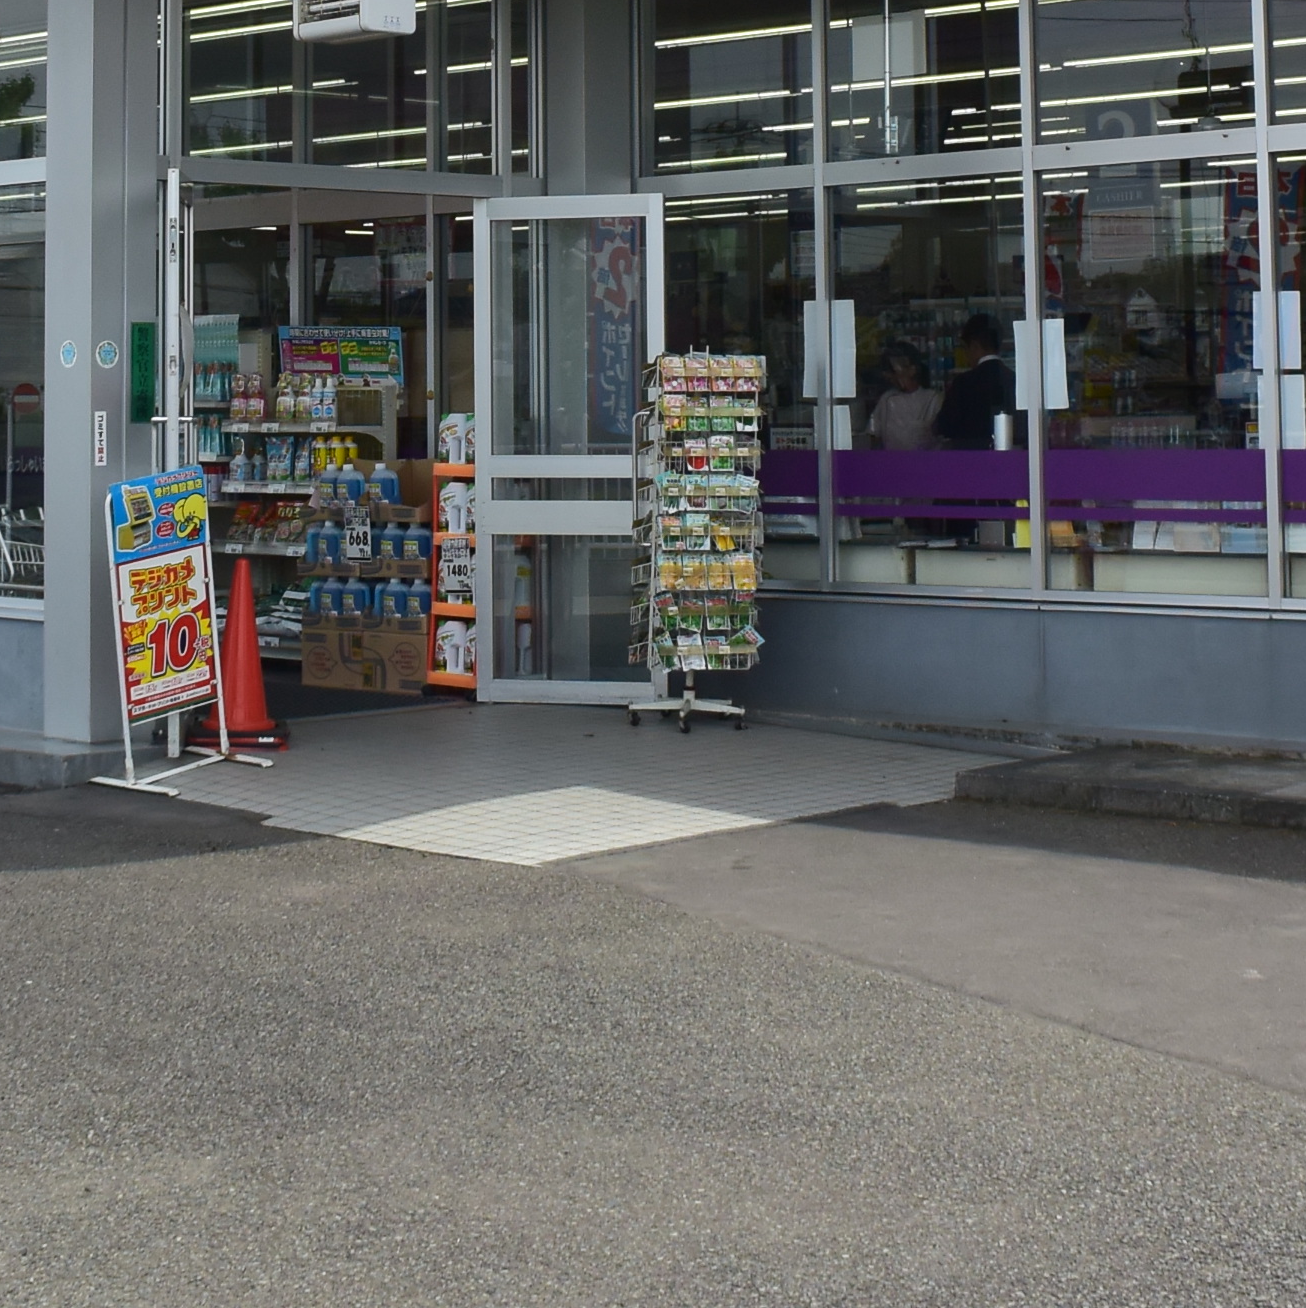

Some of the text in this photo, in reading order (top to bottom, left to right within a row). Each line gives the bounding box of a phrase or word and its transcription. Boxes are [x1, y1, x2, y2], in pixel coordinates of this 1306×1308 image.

[96, 414, 105, 463] ゴミすて禁止
[349, 530, 369, 546] 668
[129, 555, 196, 594] デジカメ
[447, 564, 468, 577] 1480
[130, 583, 197, 618] プリント
[147, 612, 201, 679] 10
